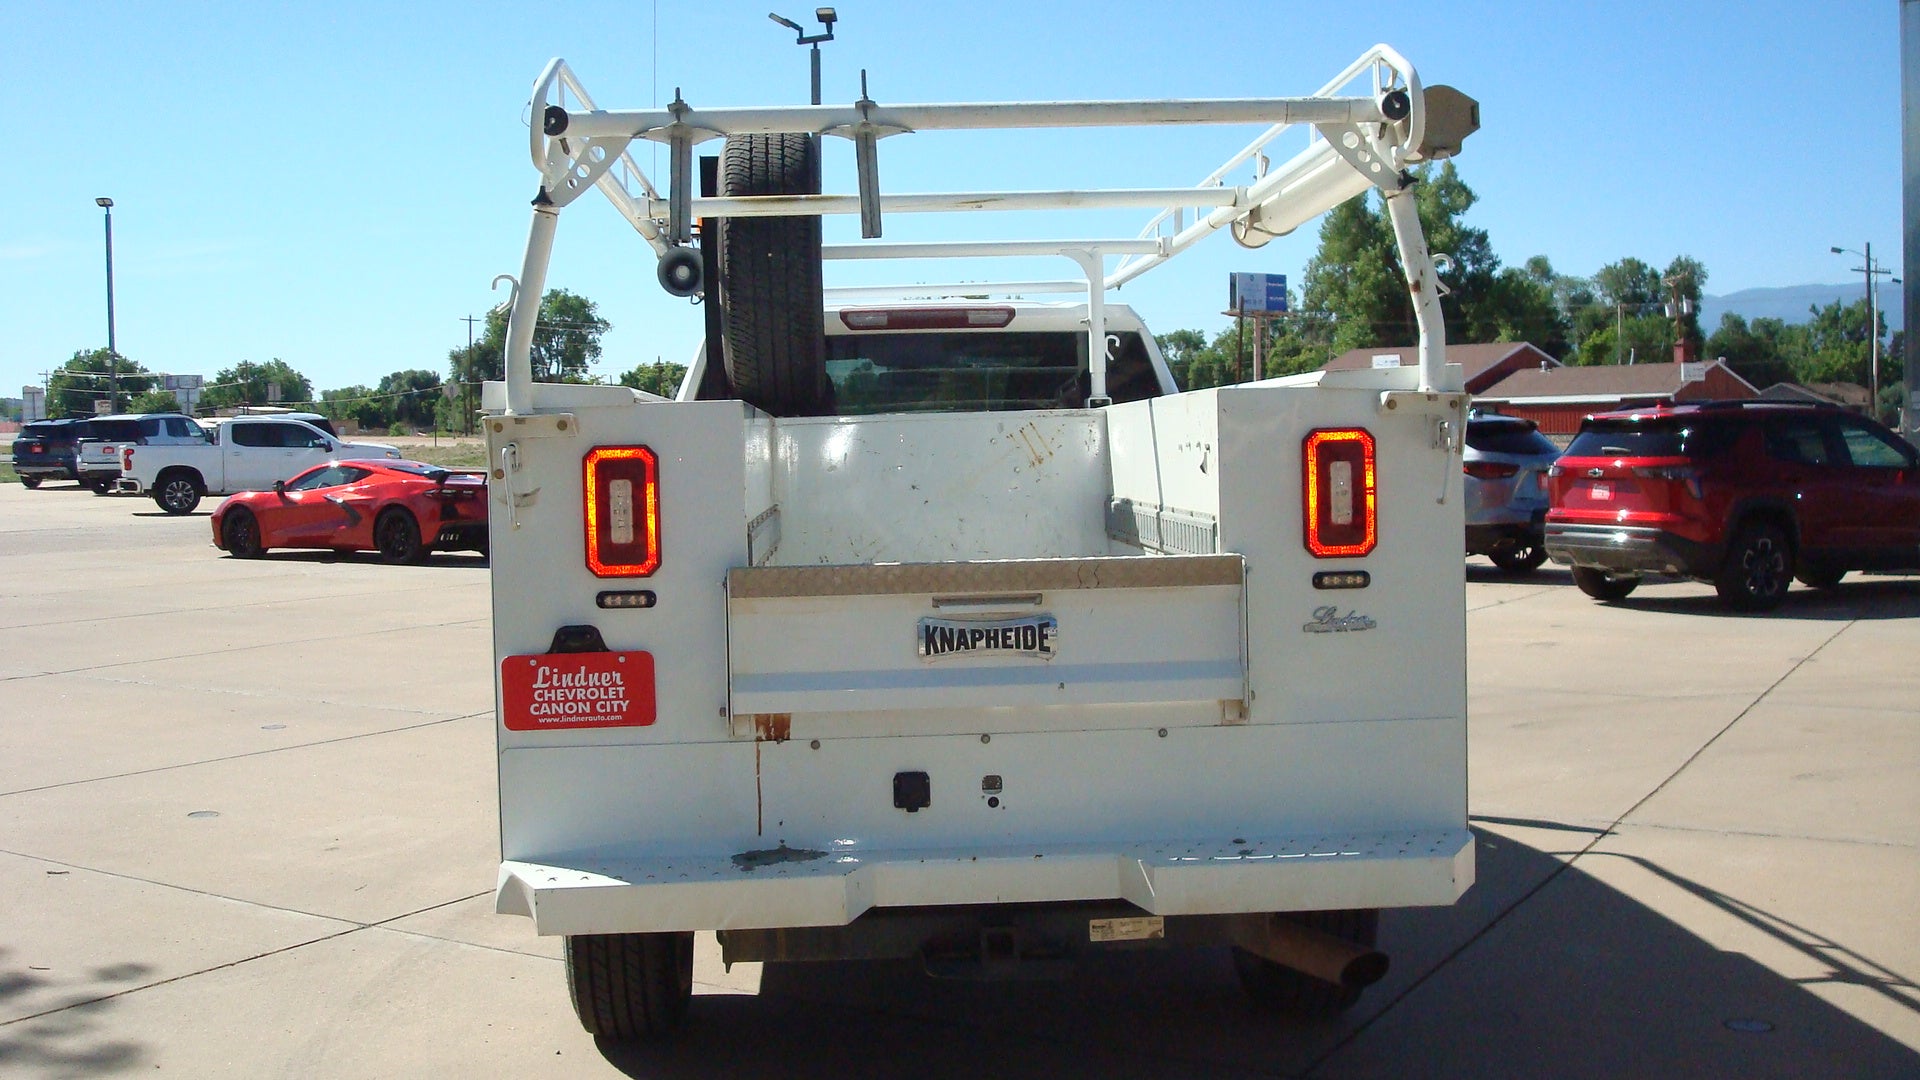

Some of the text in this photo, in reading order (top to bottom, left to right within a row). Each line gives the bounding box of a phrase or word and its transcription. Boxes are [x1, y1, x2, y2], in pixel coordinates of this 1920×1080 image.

[925, 621, 1050, 656] KNAPHEIDE
[532, 666, 624, 688] Lindner
[533, 687, 625, 701] CHEVROLET
[530, 700, 630, 715] CANON CITY
[538, 714, 622, 723] www.lindnerauto.com
